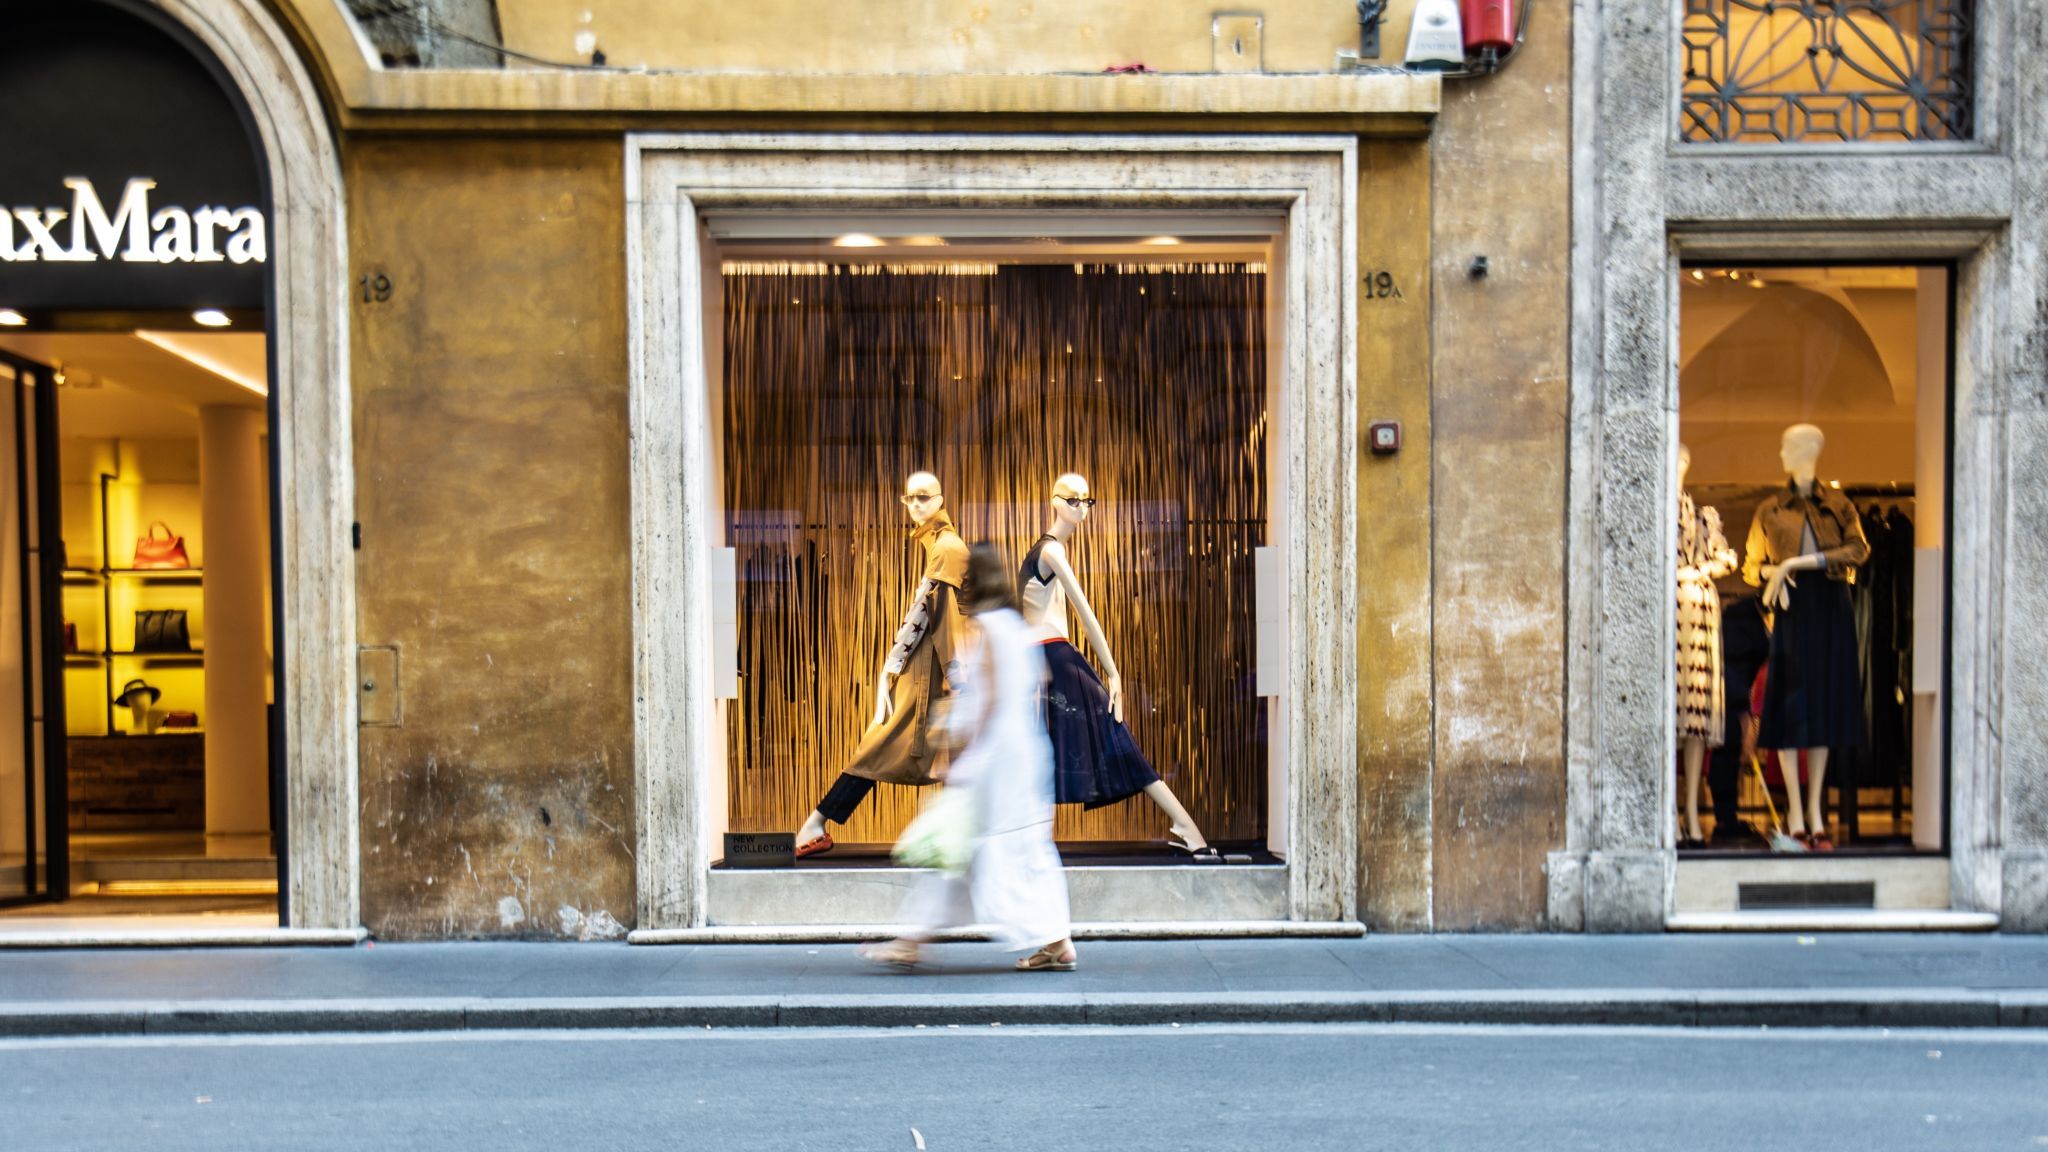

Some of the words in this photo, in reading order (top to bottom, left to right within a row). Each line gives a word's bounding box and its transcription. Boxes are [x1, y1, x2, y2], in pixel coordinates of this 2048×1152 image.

[359, 273, 392, 304] 19
[733, 834, 756, 843] NEW
[733, 844, 793, 853] COLLECTION
